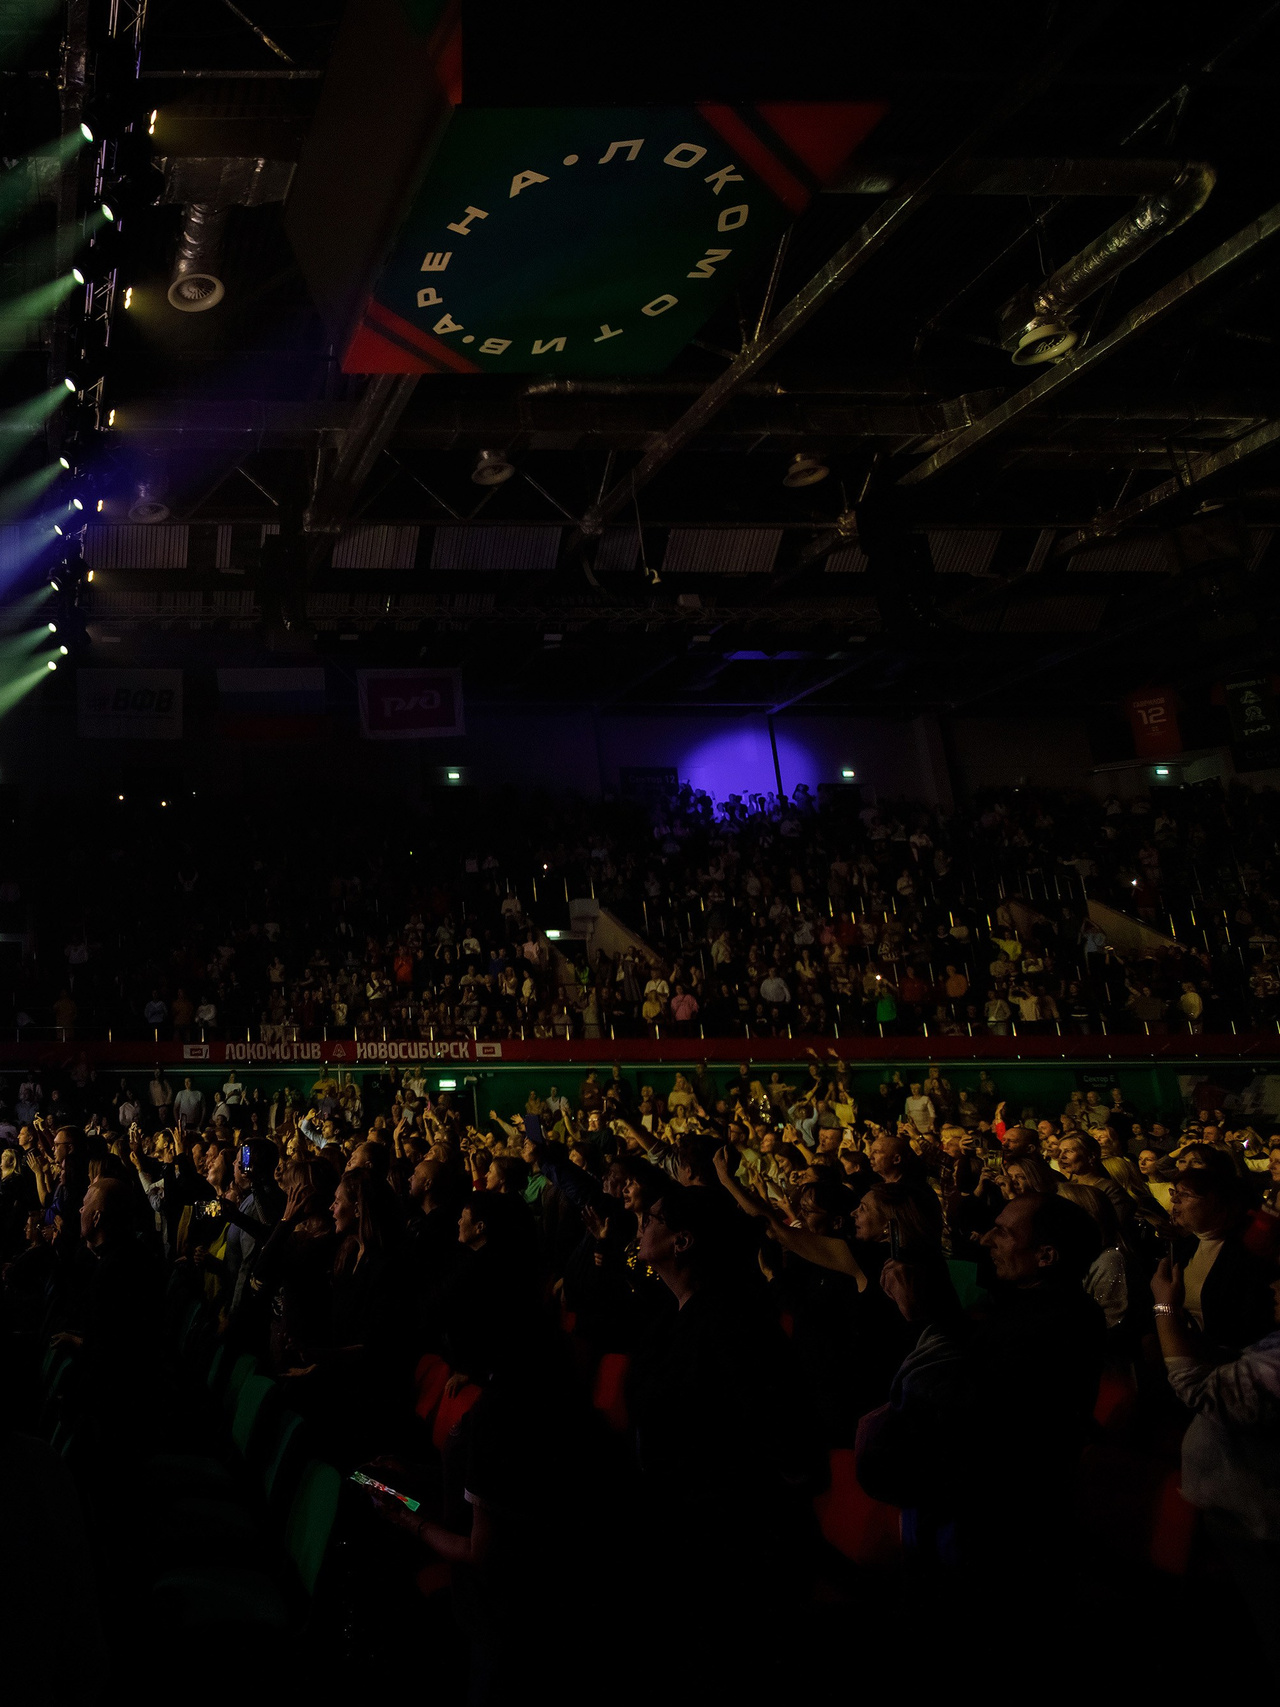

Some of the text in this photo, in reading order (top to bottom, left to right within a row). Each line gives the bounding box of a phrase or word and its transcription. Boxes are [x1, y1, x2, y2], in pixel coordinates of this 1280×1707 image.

[417, 139, 749, 355] АРЕНА ЛОКОМОТИВ
[1137, 706, 1167, 725] 12
[225, 1041, 470, 1060] ЛОКОМОТИВ НОВОСИБИРСК
